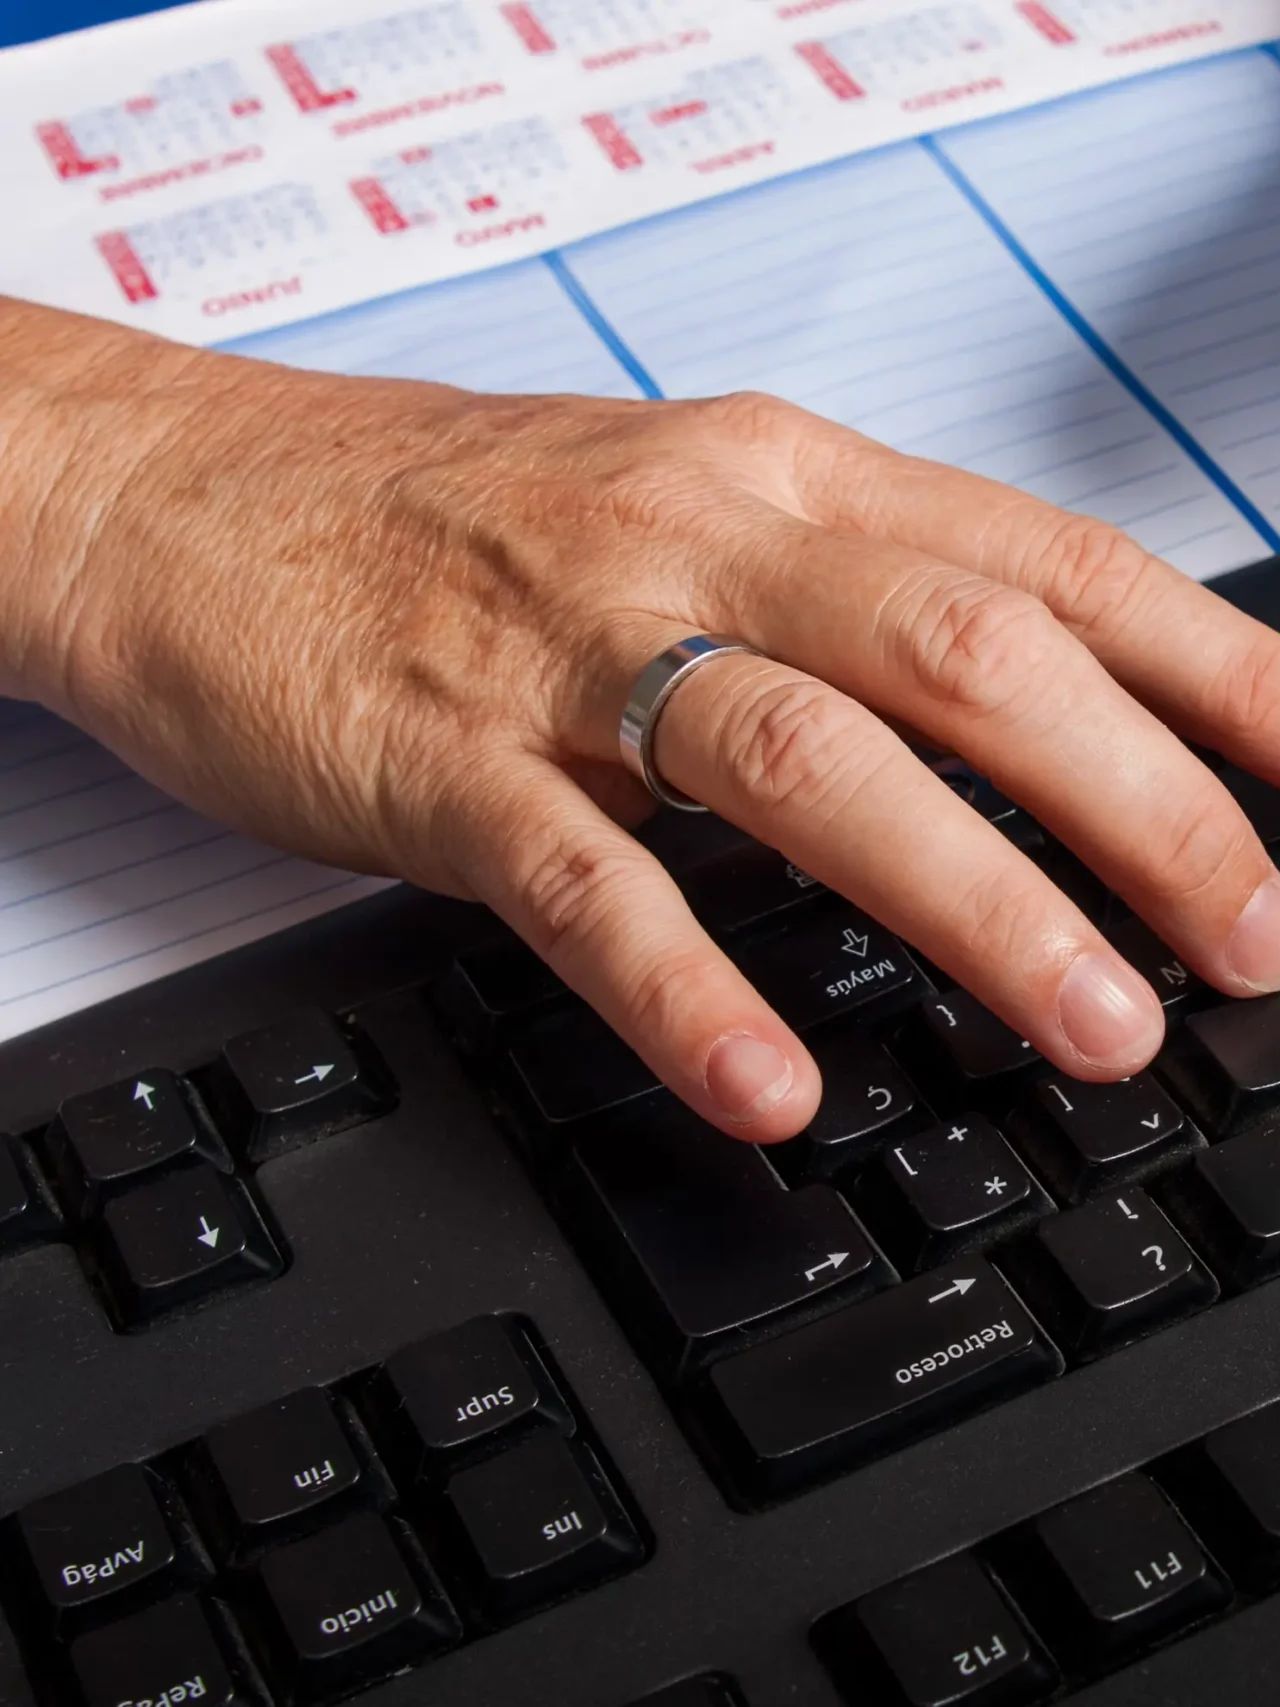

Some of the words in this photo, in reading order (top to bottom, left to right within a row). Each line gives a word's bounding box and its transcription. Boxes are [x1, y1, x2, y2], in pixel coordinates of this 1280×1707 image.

[582, 30, 711, 72] OCTUBRE
[335, 85, 499, 135] NOVIEMBRE
[902, 77, 1004, 113] MARZO
[458, 216, 542, 245] MAYO
[203, 279, 299, 314] JUNIO
[827, 960, 895, 996] Mayús
[1160, 961, 1186, 985] Ñ
[868, 1086, 891, 1110] Ç
[948, 1127, 967, 1141] +
[1142, 1246, 1166, 1271] ¿
[896, 1320, 1013, 1383] Retroceso
[458, 1386, 513, 1421] Supr
[294, 1461, 334, 1487] Fin
[543, 1512, 582, 1540] Ins
[62, 1541, 143, 1586] AvPág
[1135, 1552, 1181, 1588] F11
[320, 1591, 397, 1634] Inicio
[954, 1636, 1006, 1675] F12
